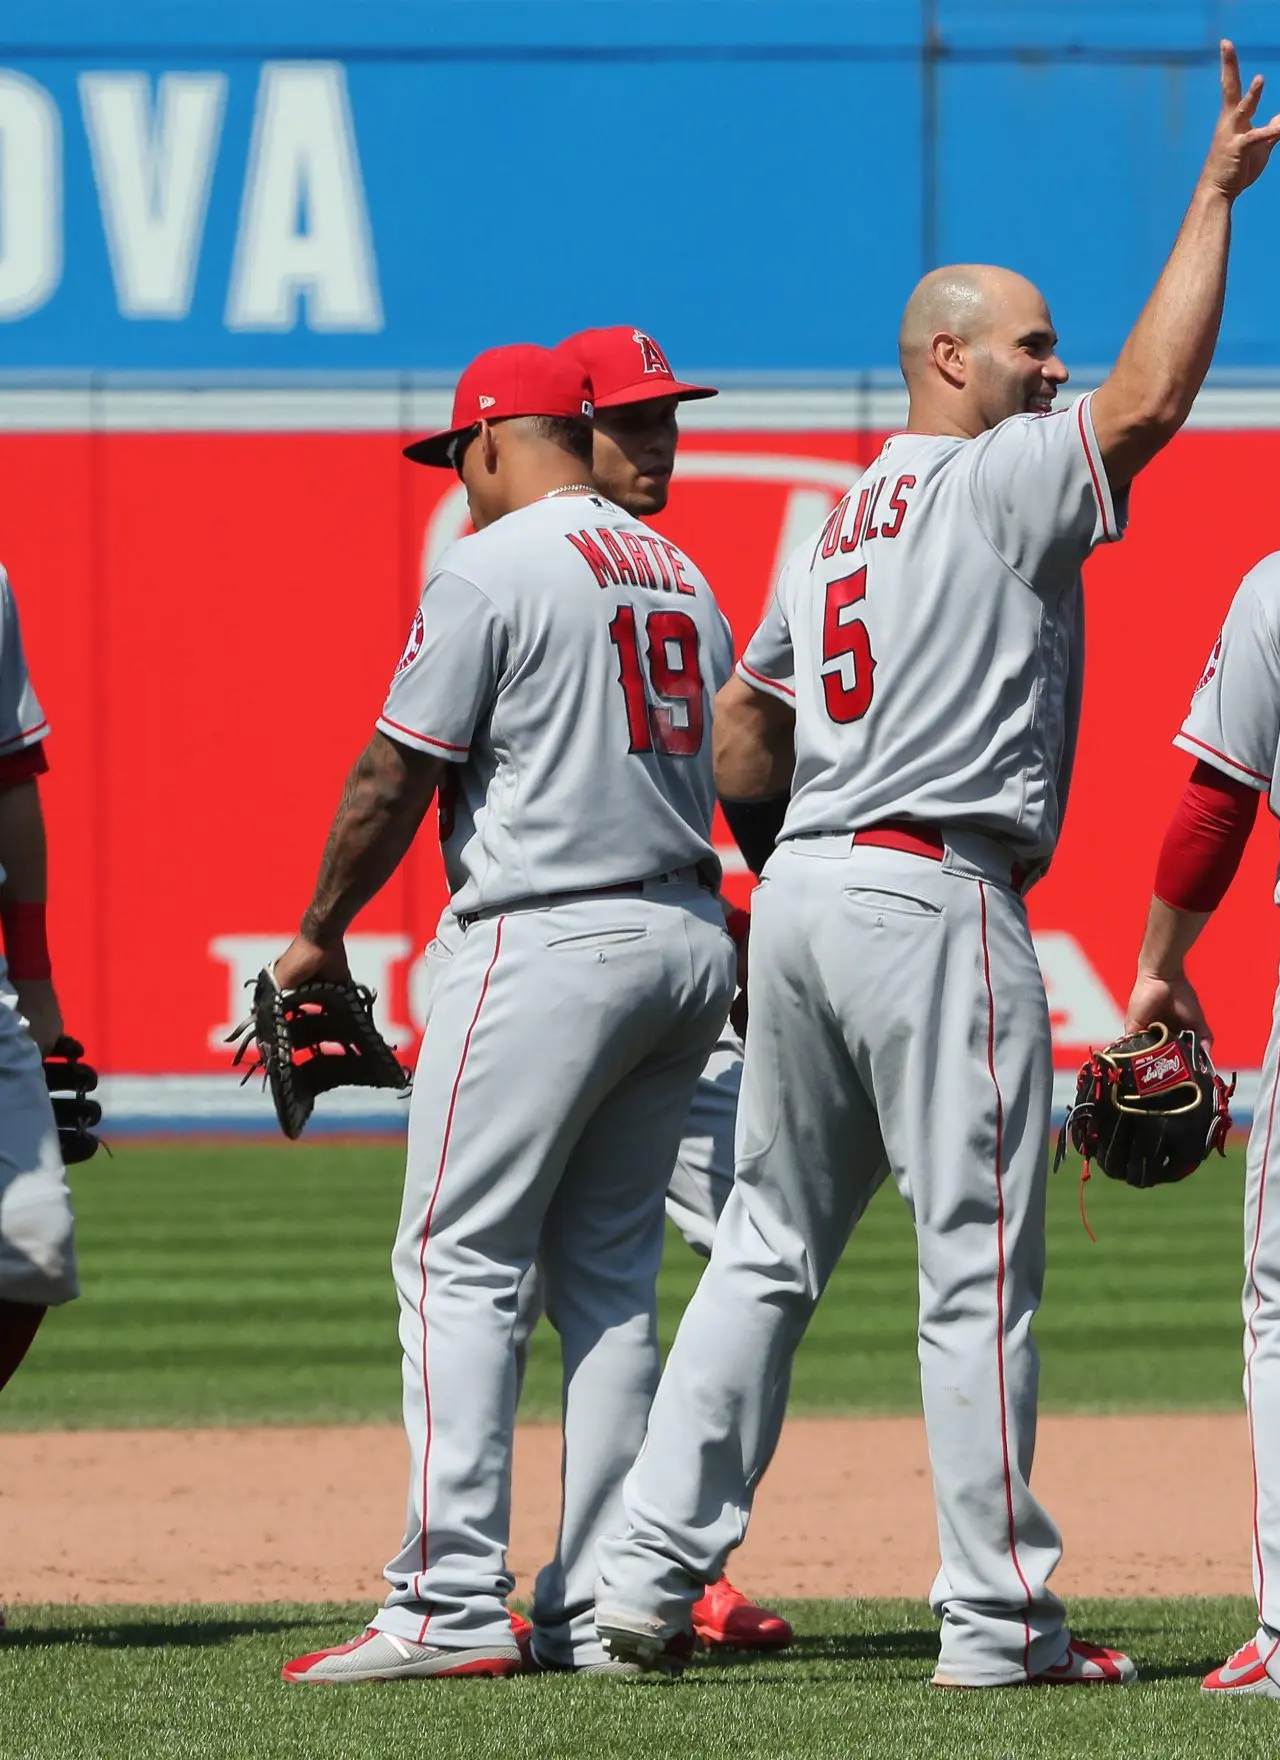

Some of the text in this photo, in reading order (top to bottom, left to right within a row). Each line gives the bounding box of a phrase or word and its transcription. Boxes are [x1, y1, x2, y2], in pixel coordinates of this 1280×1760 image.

[565, 527, 697, 597] MARTE
[608, 604, 704, 755] 19
[820, 564, 878, 725] 5
